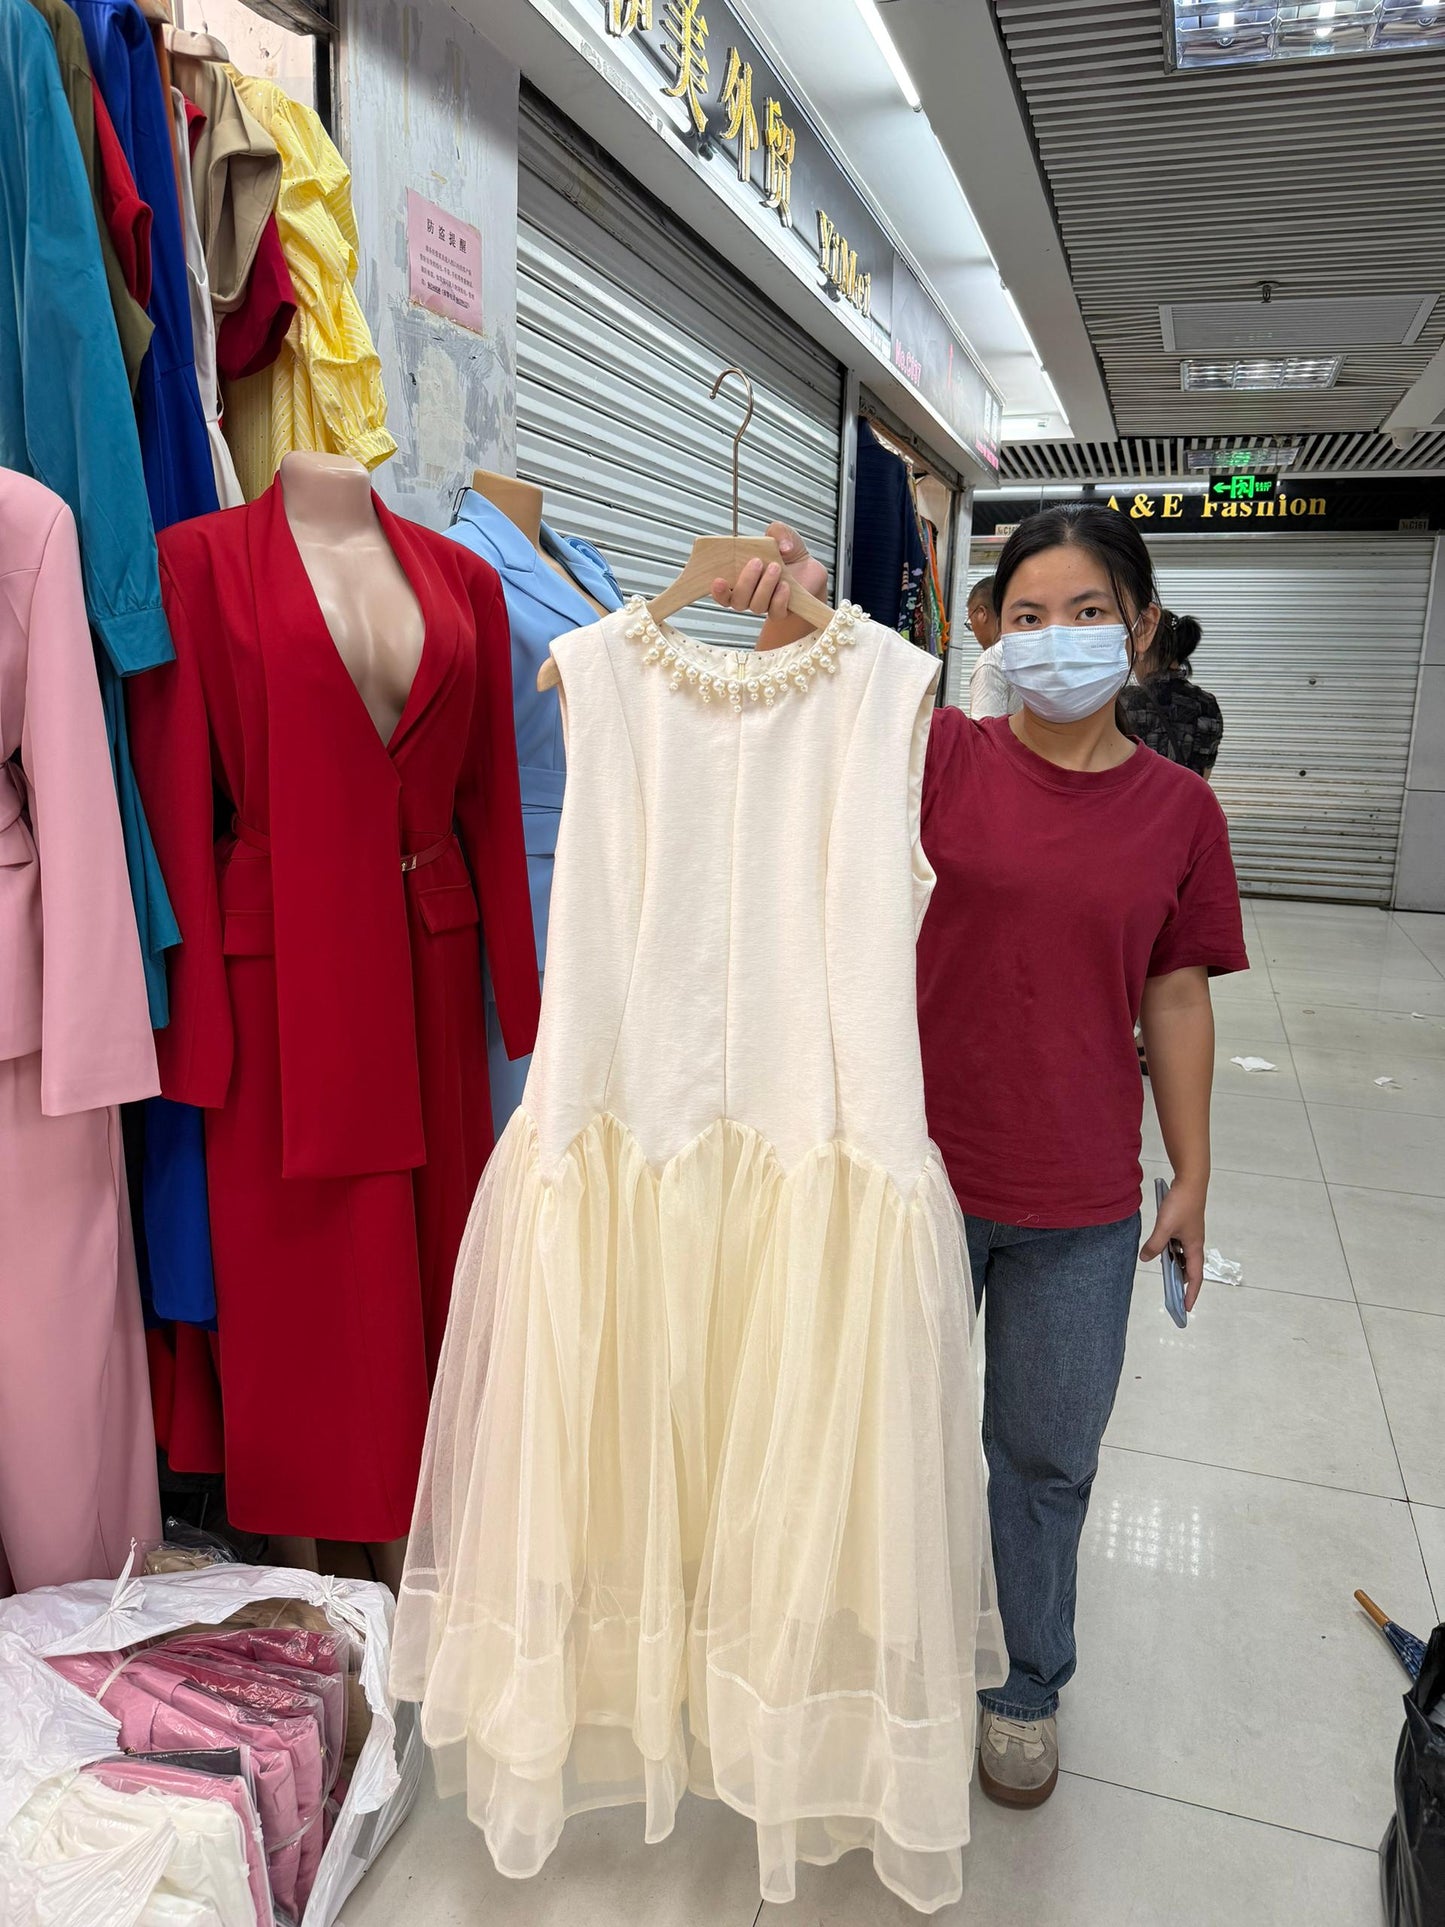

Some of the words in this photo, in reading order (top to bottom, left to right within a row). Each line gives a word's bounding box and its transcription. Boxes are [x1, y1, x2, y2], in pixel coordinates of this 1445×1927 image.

[604, 0, 796, 228] 美外贸
[426, 218, 467, 254] 防盗提醒
[1129, 493, 1155, 518] &
[1160, 493, 1183, 518] E
